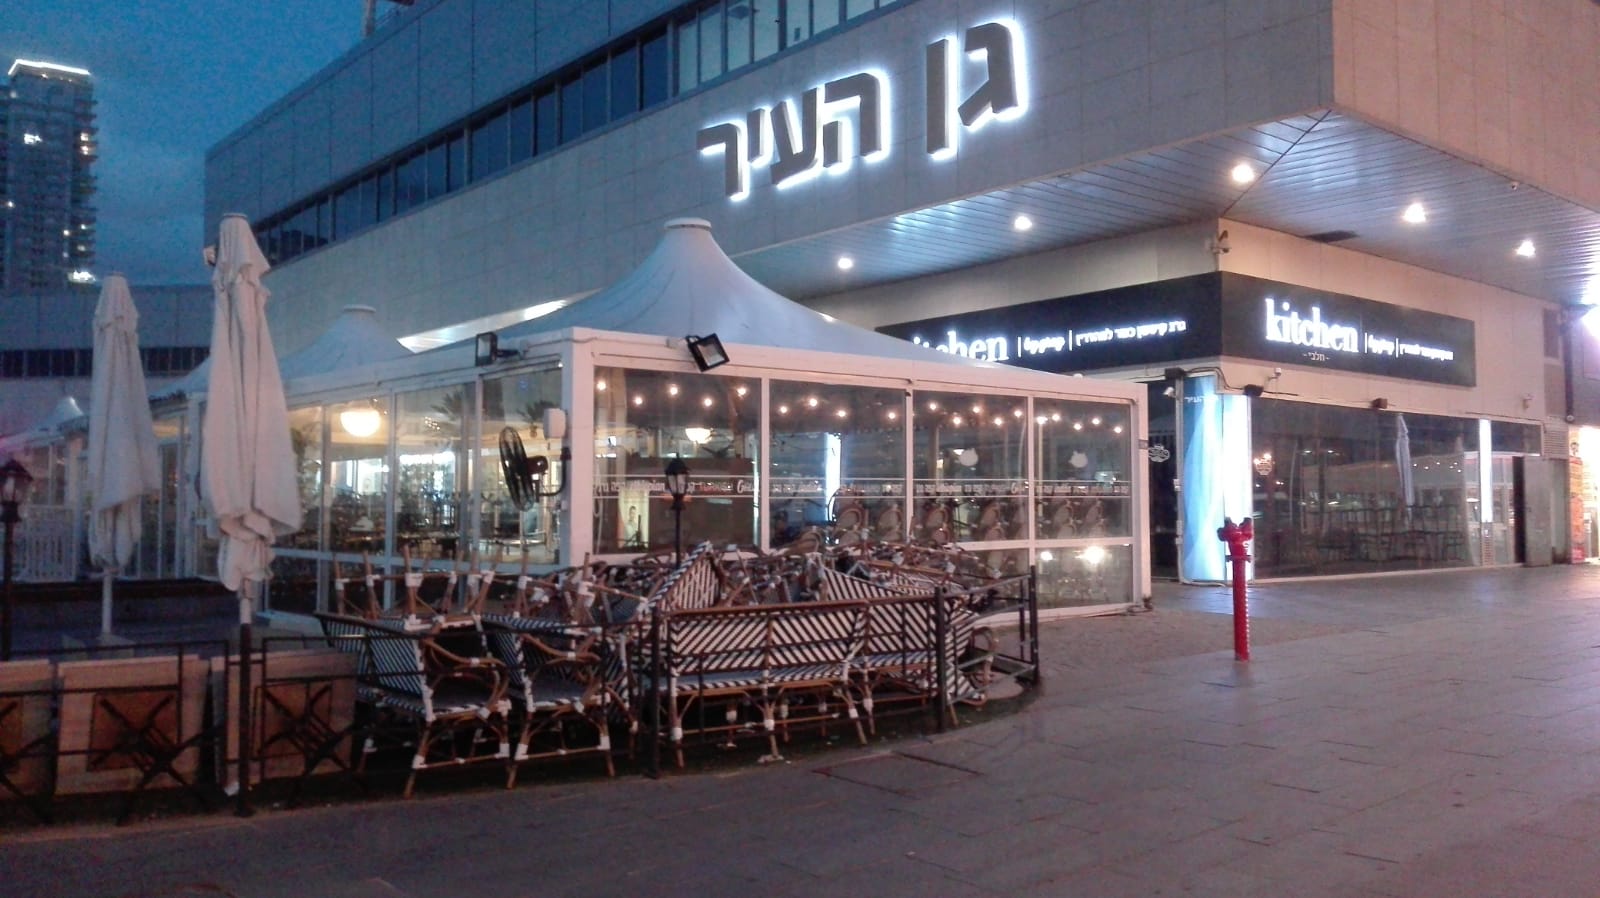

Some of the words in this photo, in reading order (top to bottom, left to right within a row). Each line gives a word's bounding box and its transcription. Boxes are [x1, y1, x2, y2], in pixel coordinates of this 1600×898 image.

[697, 71, 886, 199] העיר
[926, 20, 1024, 158] גן
[1265, 298, 1359, 353] kitchen
